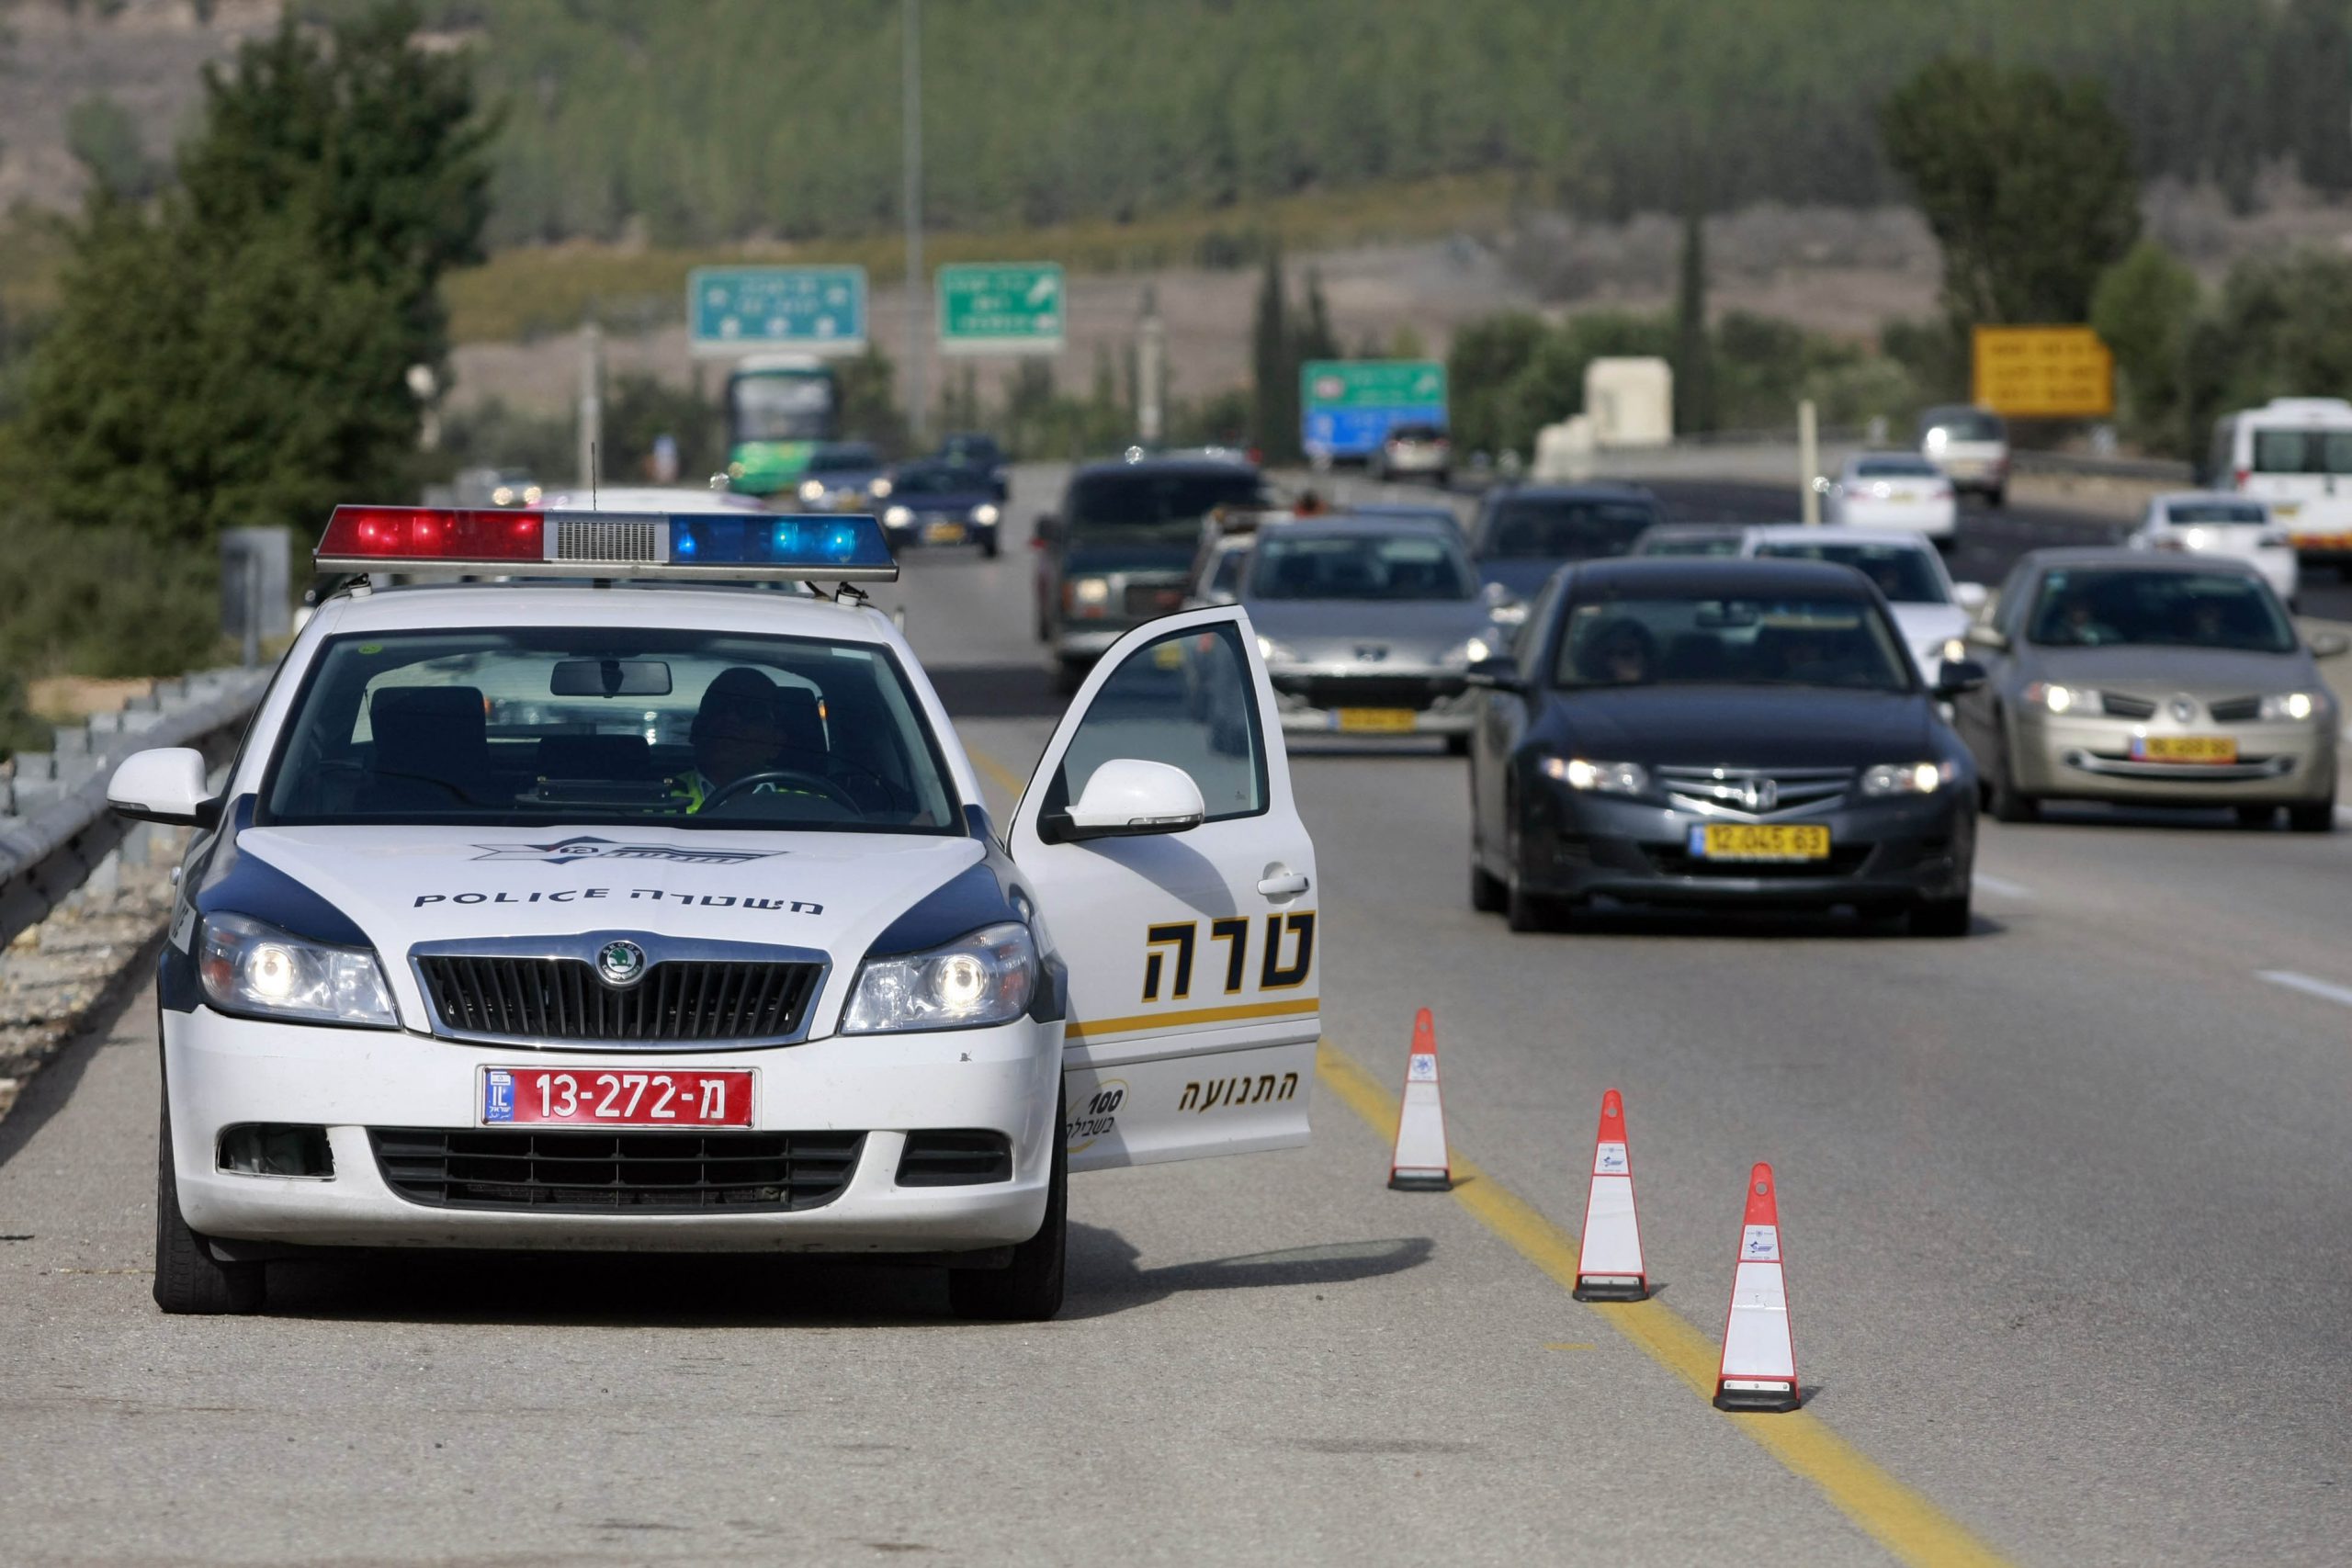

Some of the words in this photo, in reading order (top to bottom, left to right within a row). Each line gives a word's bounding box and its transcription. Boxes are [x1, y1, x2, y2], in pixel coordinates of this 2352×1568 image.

[413, 888, 610, 908] POLICE
[630, 889, 824, 915] משטרה
[1141, 910, 1316, 1002] טרה
[492, 1086, 507, 1106] IL
[1088, 1089, 1124, 1115] 100
[1178, 1071, 1299, 1115] התנועה
